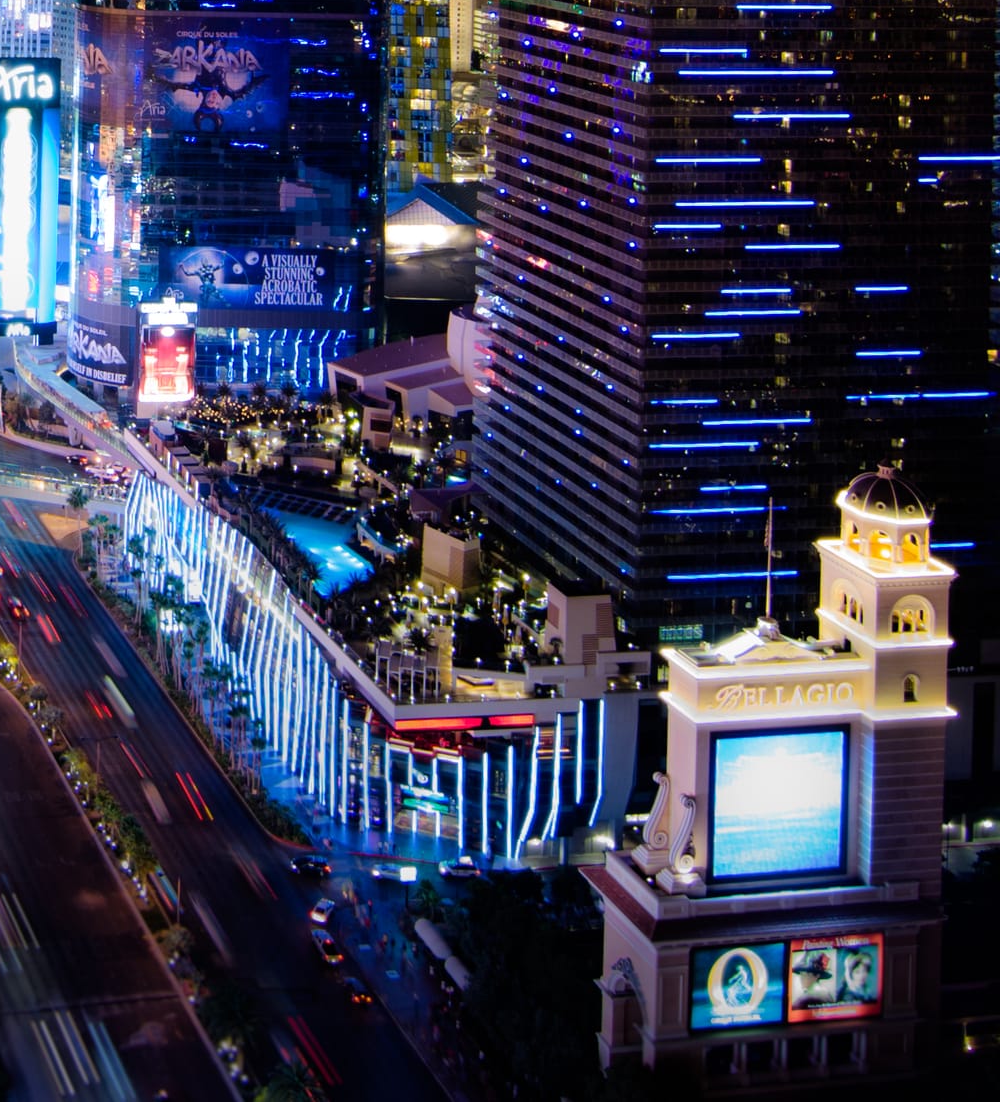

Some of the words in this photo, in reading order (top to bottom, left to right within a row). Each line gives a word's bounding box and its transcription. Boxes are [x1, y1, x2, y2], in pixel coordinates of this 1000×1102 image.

[176, 30, 201, 38] CIRQUE
[152, 40, 263, 73] ZARKANA
[261, 254, 269, 267] A
[271, 254, 317, 268] VISUALLY
[264, 267, 314, 281] STUNNING
[261, 279, 317, 293] ACROBATIC
[254, 291, 323, 306] SPECTACULAR
[710, 682, 854, 713] BELLAGIO
